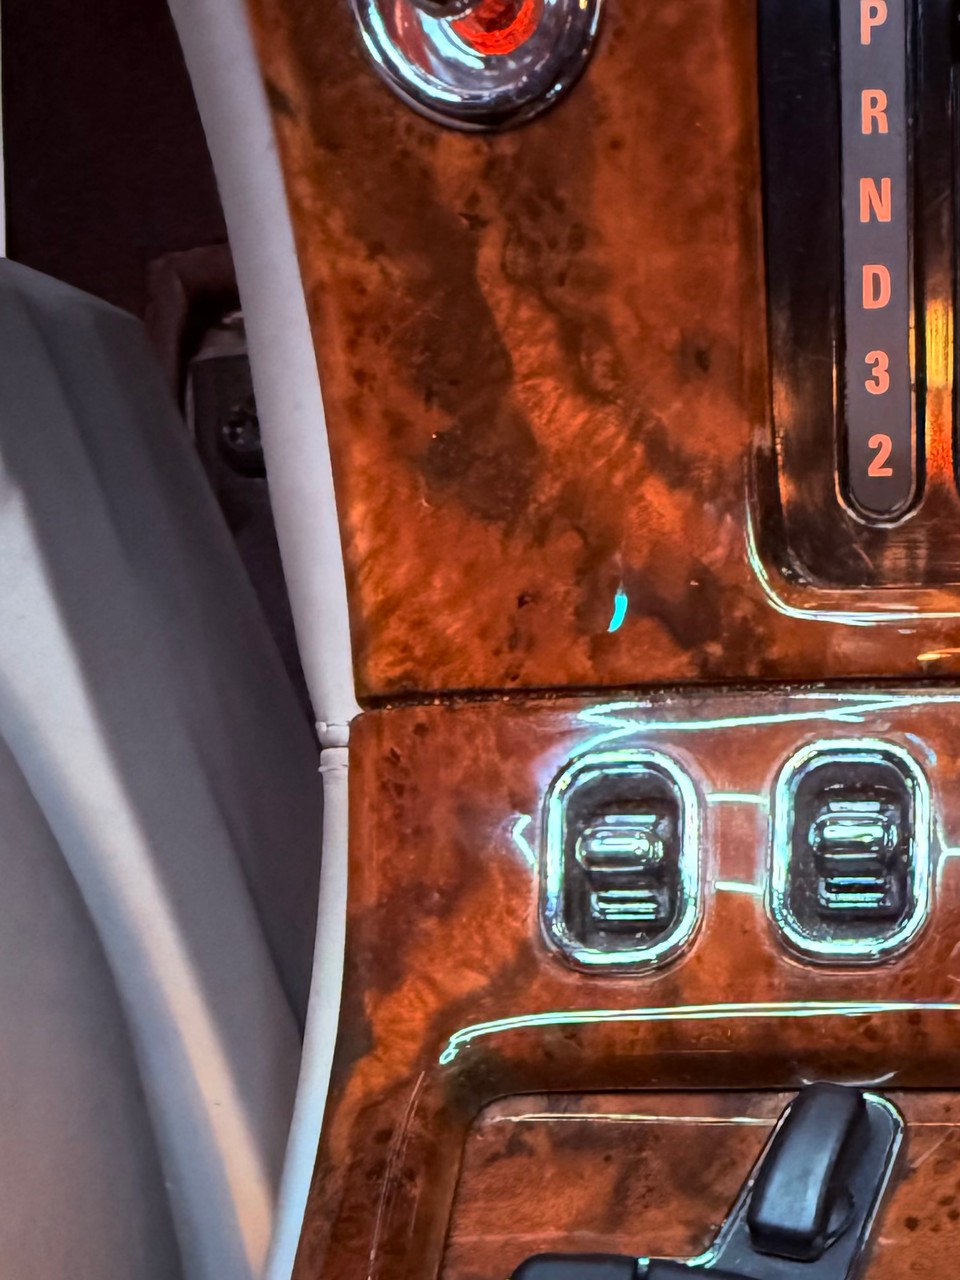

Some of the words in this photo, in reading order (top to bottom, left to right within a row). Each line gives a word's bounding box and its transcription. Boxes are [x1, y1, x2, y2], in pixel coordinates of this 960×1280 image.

[860, 0, 888, 45] P
[861, 89, 889, 135] R
[859, 177, 892, 223] N
[862, 264, 891, 310] D
[864, 350, 890, 395] 3
[867, 433, 893, 477] 2
